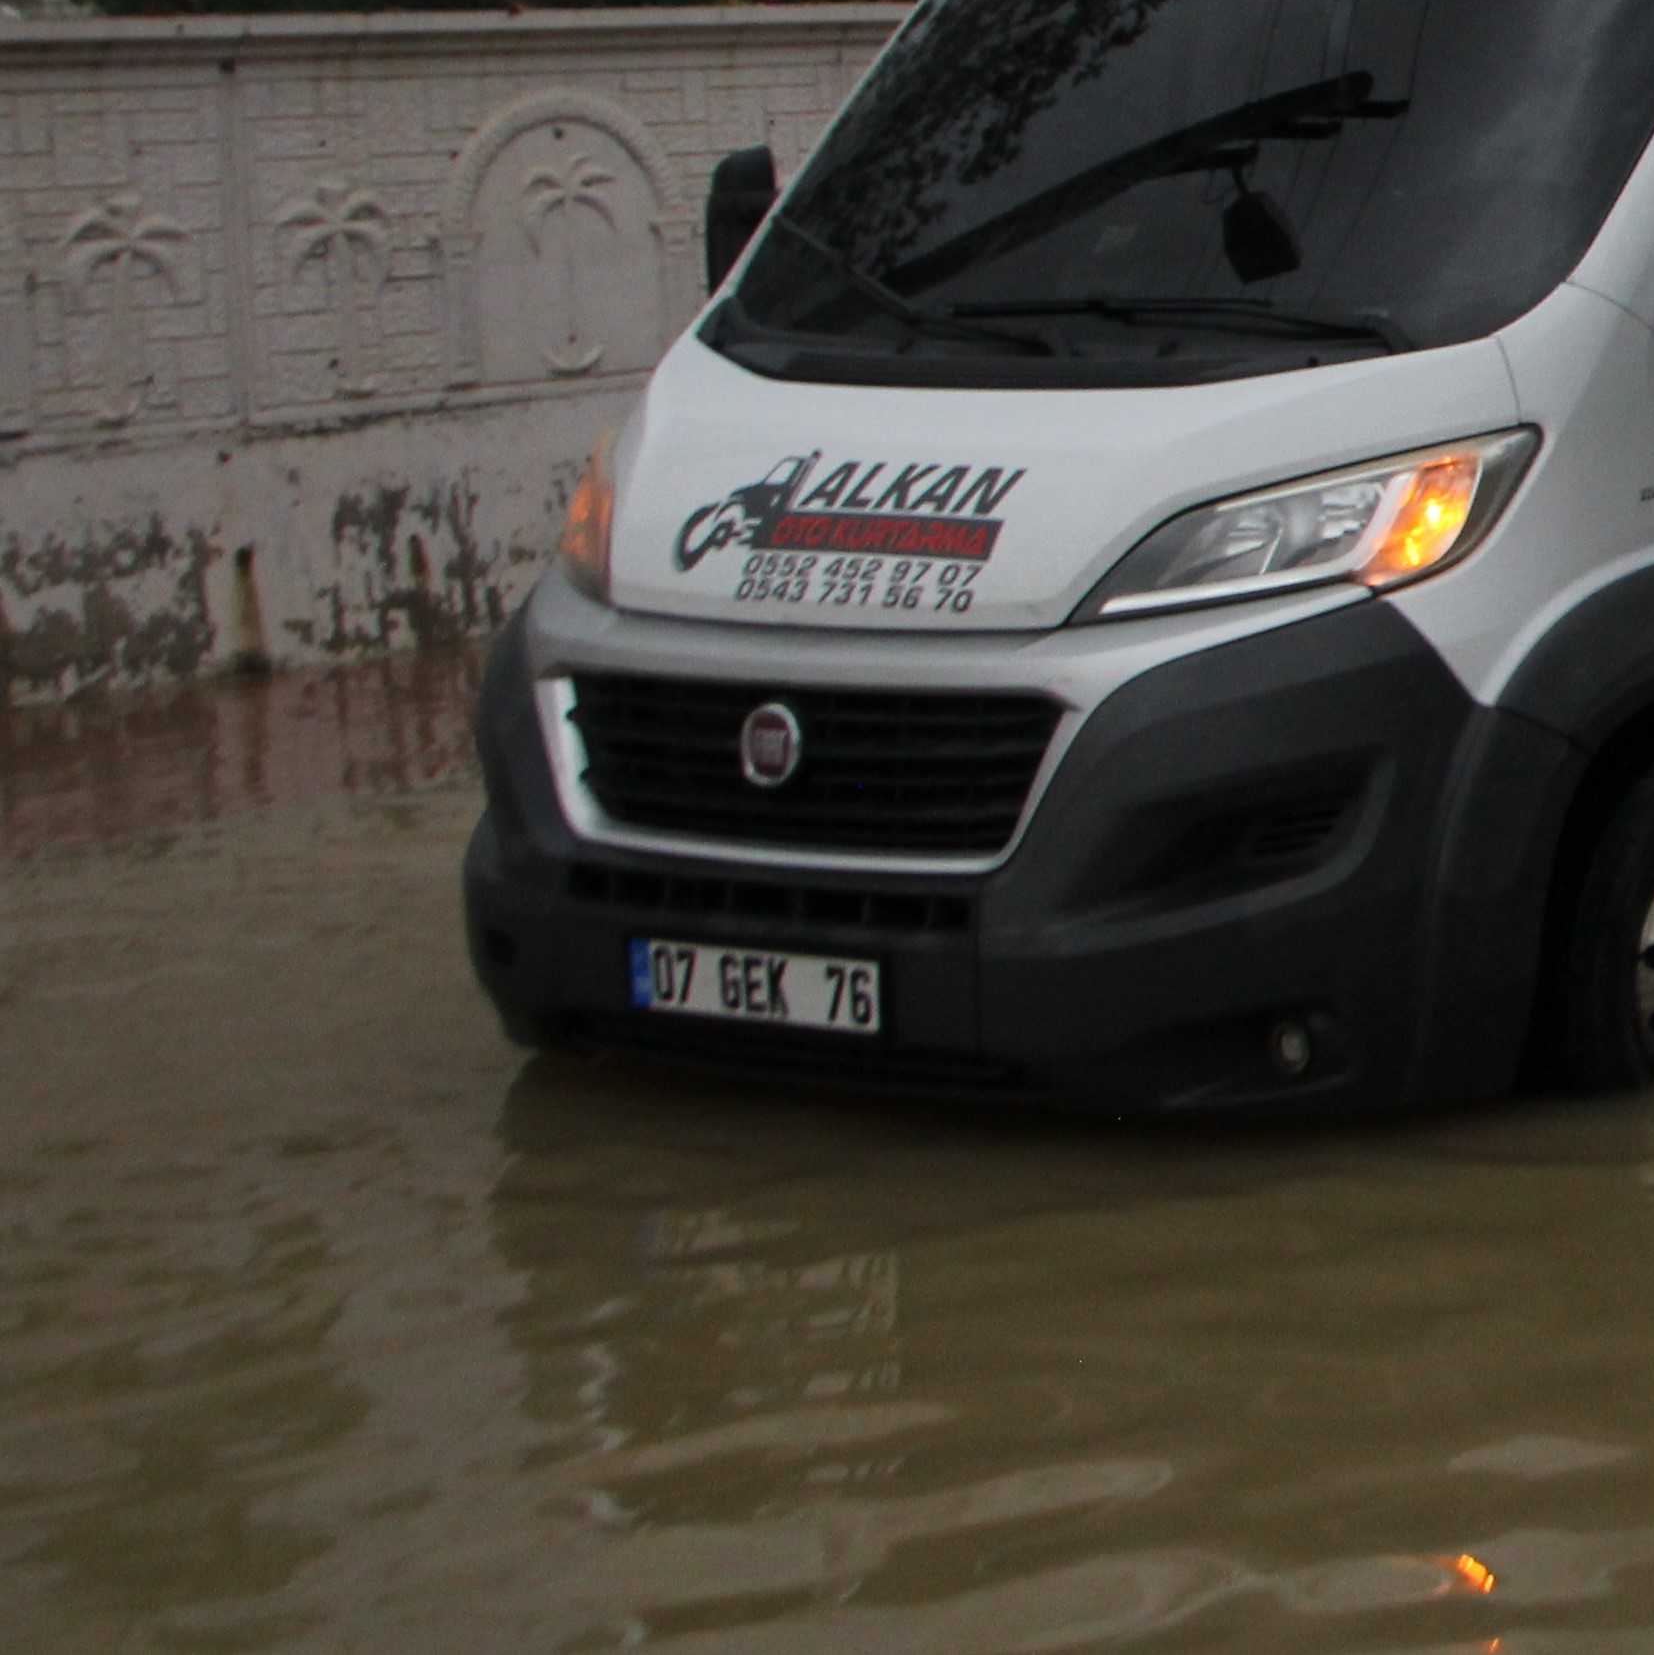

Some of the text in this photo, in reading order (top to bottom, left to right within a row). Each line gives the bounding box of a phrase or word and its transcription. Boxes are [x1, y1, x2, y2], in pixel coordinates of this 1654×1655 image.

[803, 461, 1025, 516] ALKAN
[771, 515, 989, 555] OTO KURTARMA
[743, 553, 983, 588] 0552 452 97 07
[735, 578, 974, 613] 0543 731 56 70
[653, 947, 873, 1025] 07 GEK 76
